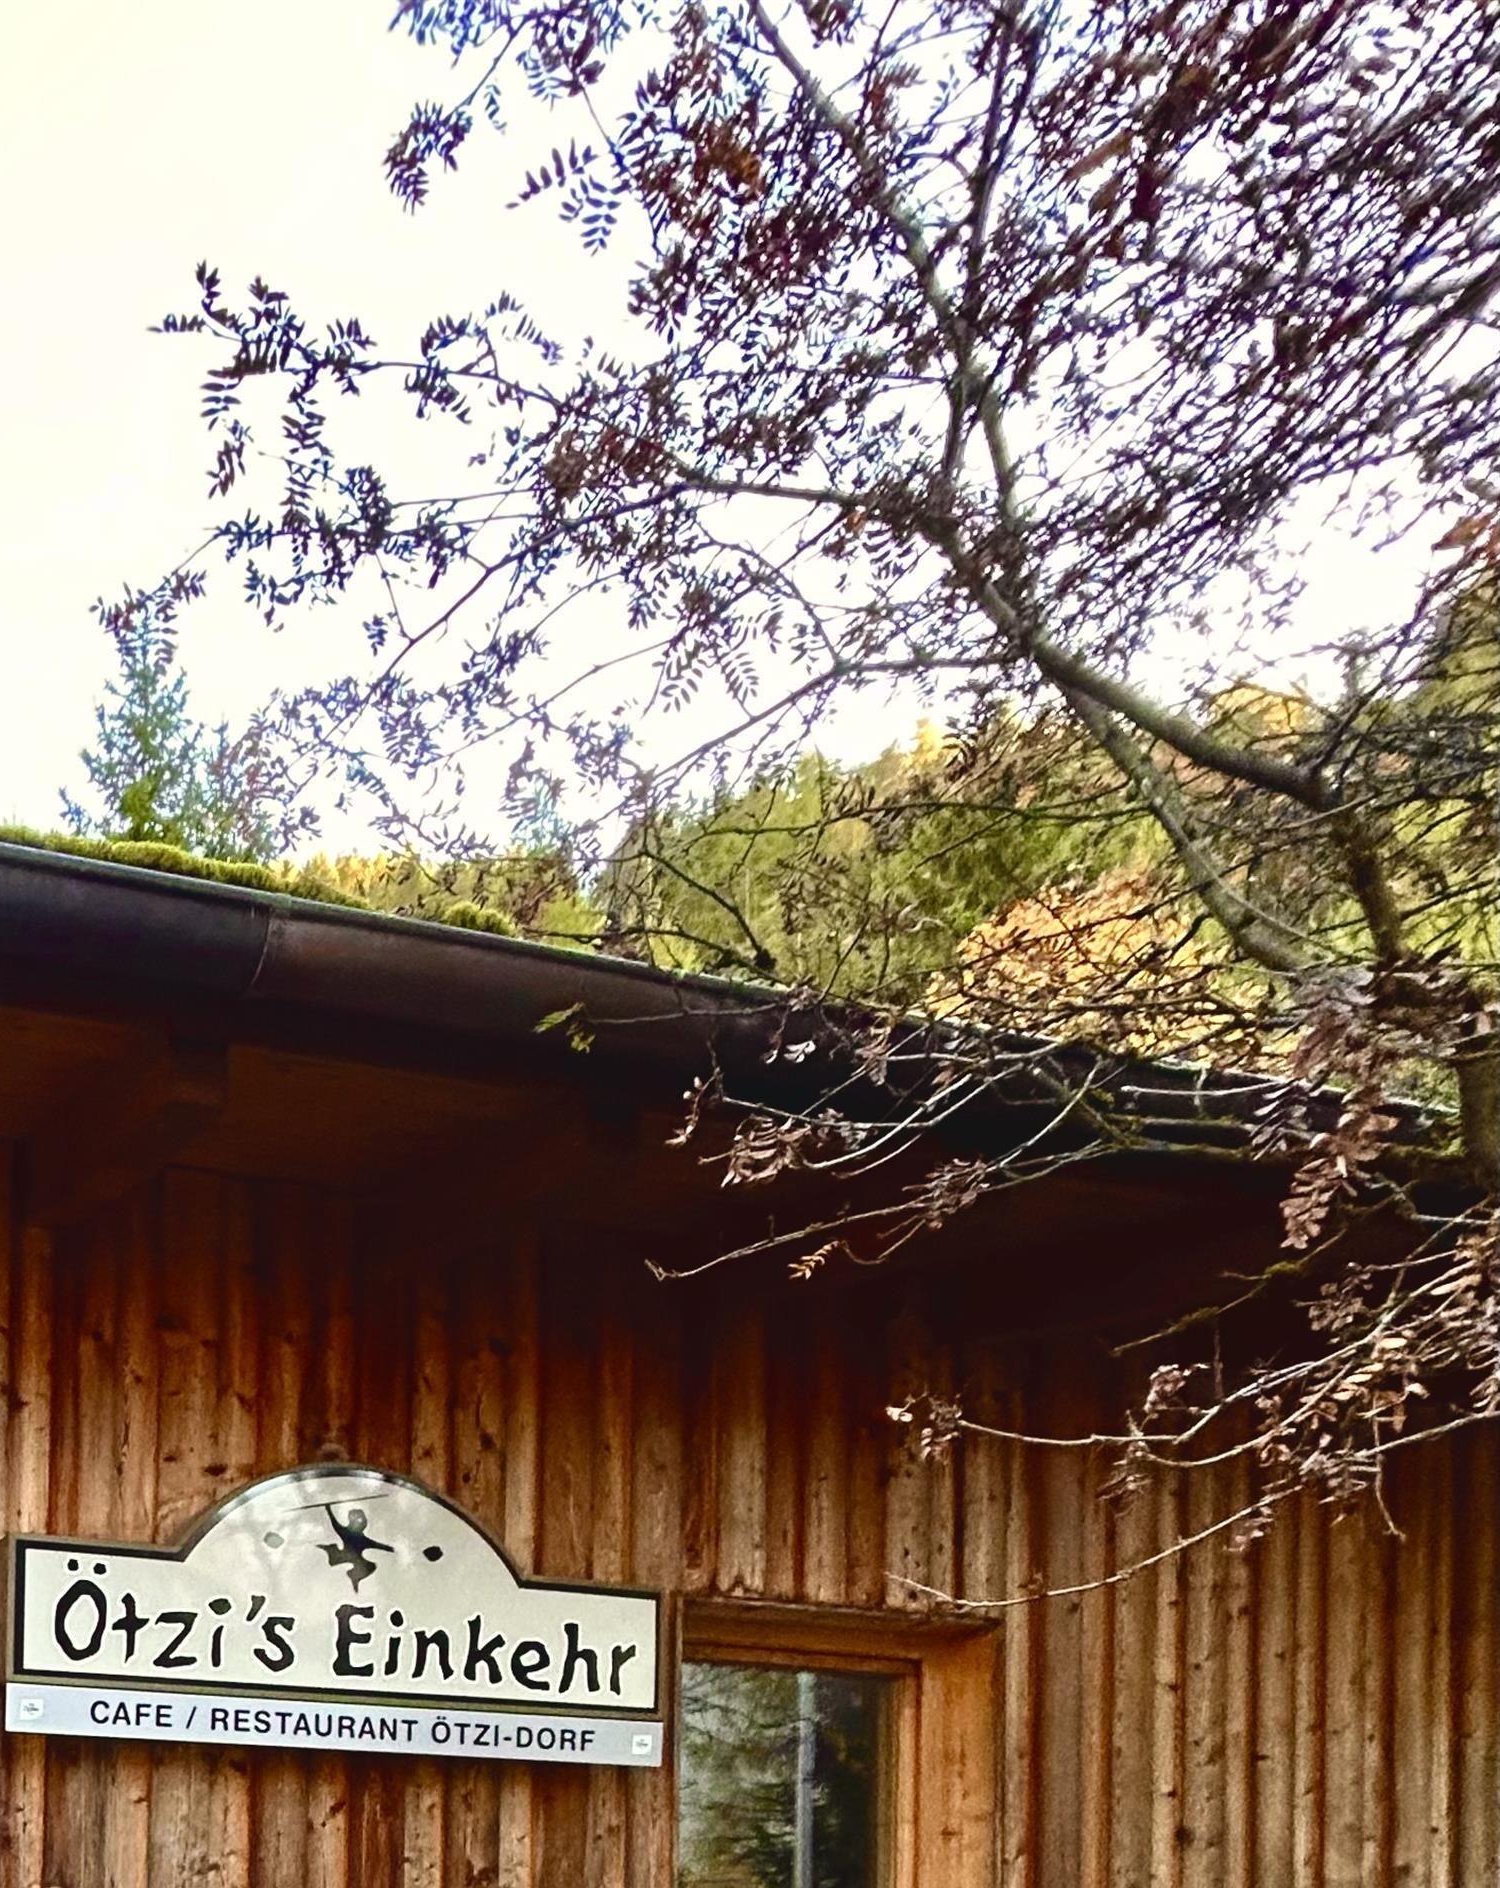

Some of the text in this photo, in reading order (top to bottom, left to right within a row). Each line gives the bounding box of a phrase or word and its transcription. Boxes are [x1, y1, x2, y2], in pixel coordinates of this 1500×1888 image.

[54, 1557, 637, 1697] Ötzi's Einkehr
[89, 1700, 596, 1753] CAFE / RESTAURANT ÖTZI-DORF
